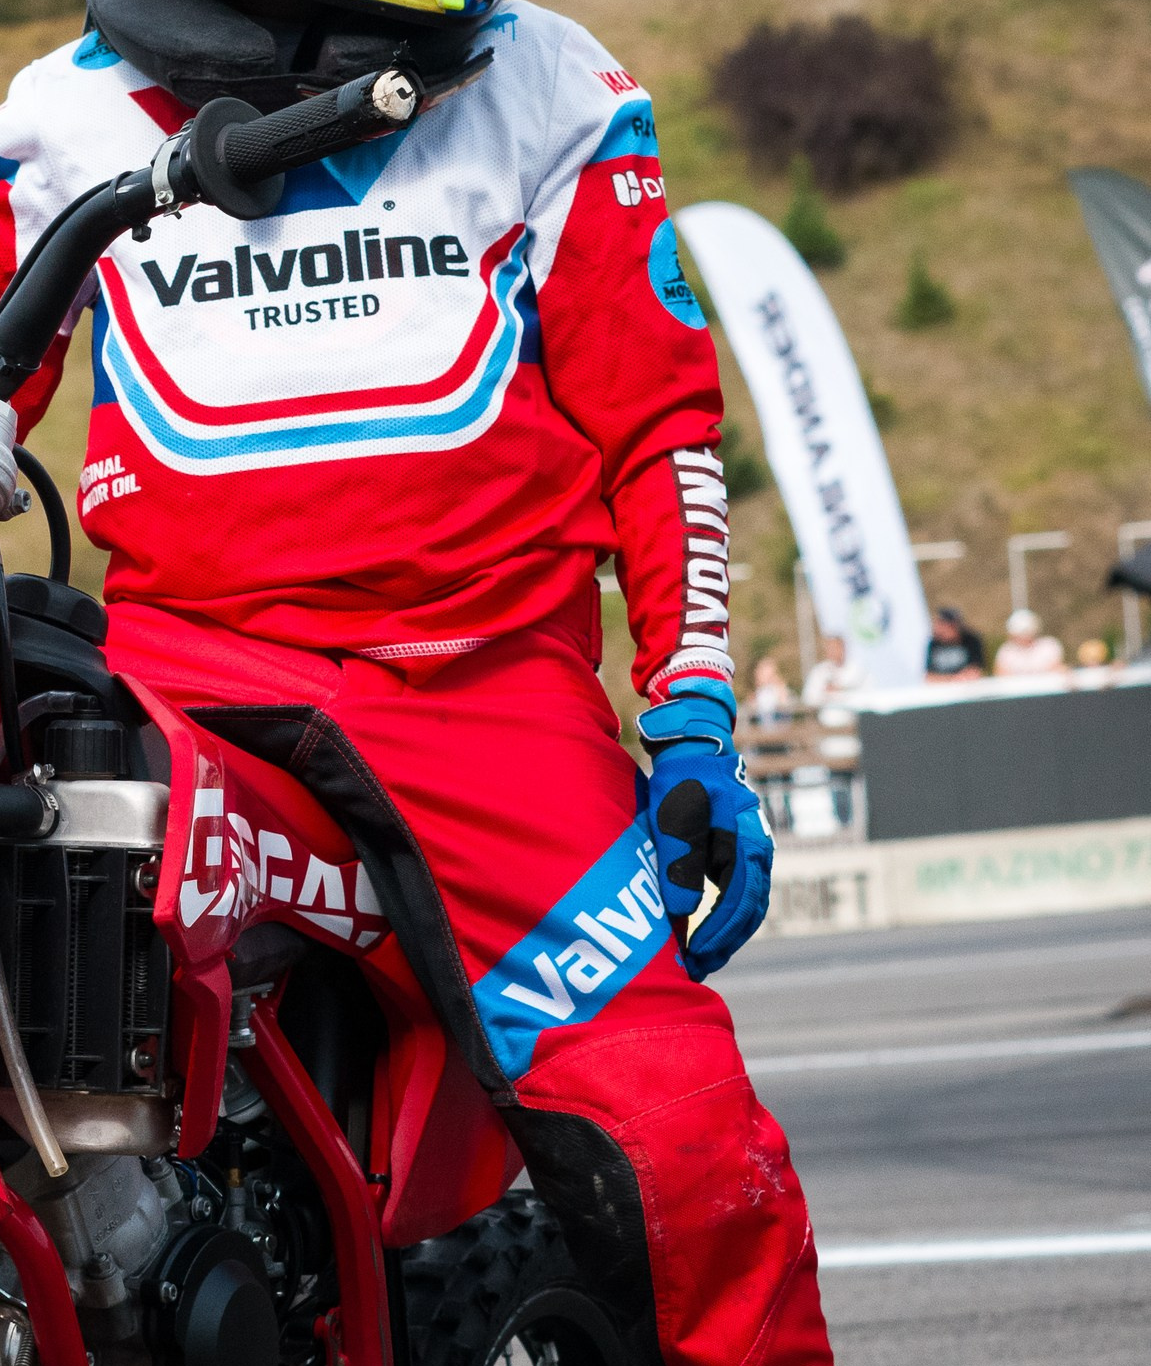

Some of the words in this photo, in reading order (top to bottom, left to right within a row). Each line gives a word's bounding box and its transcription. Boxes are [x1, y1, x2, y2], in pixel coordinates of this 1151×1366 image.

[141, 228, 469, 308] Valvoline
[244, 293, 380, 332] TRUSTED
[111, 472, 142, 499] OIL
